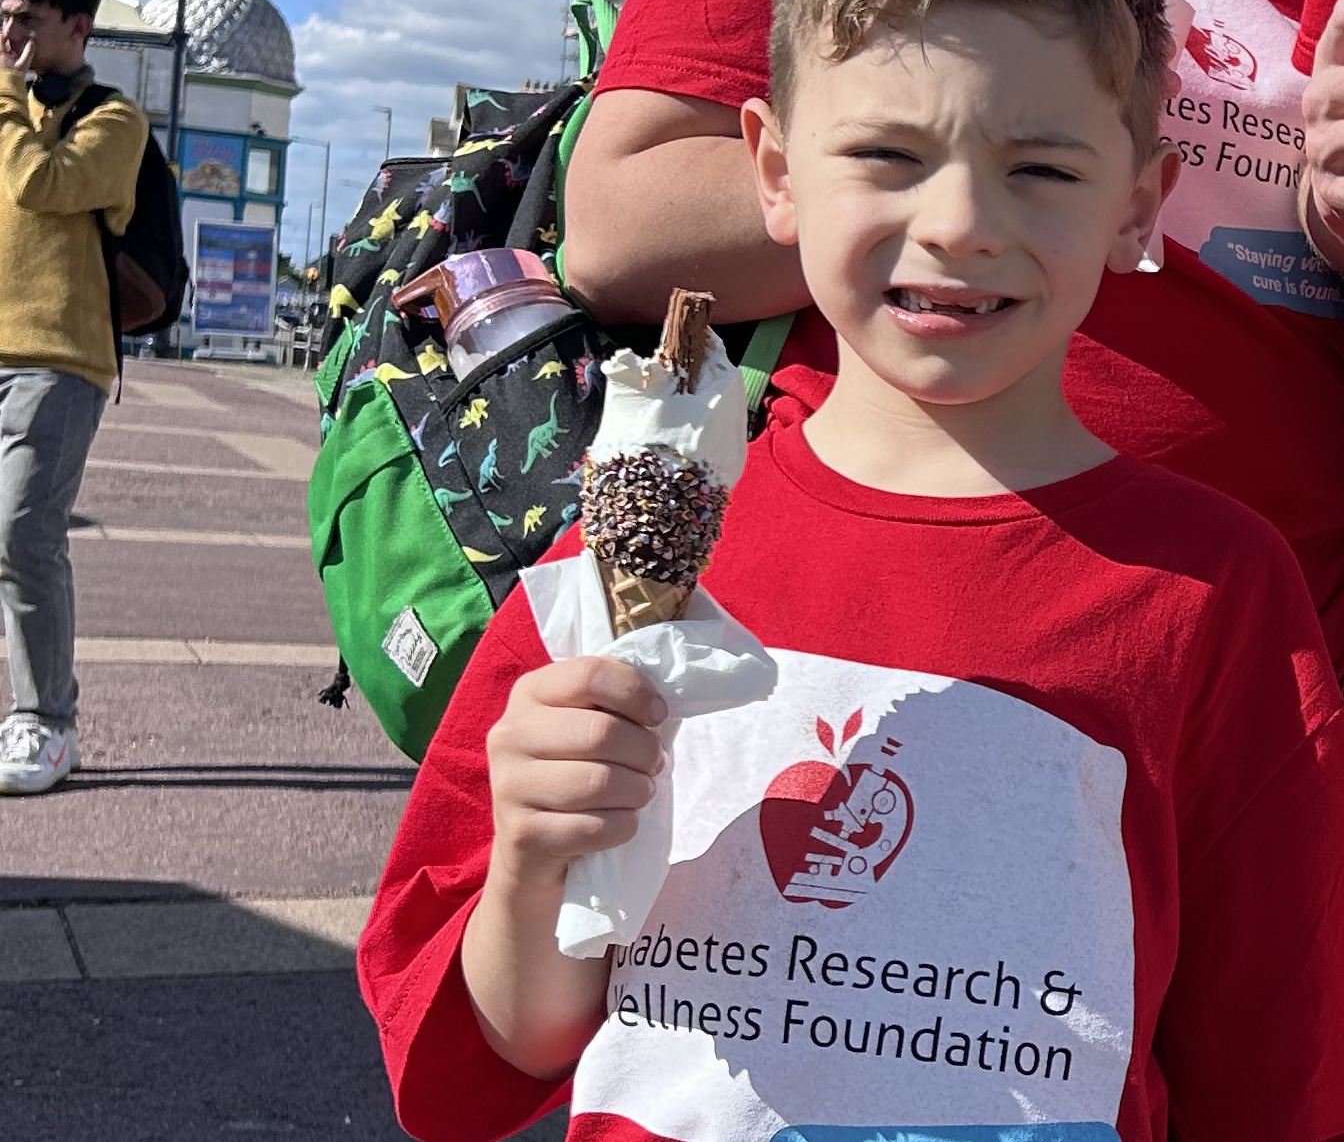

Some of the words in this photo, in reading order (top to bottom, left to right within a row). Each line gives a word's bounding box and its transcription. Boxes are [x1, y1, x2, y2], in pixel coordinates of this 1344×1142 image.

[1252, 275, 1282, 292] cure
[1285, 277, 1297, 294] is
[787, 936, 1022, 1010] Research
[1040, 969, 1083, 1016] &
[781, 999, 1074, 1081] Foundation
